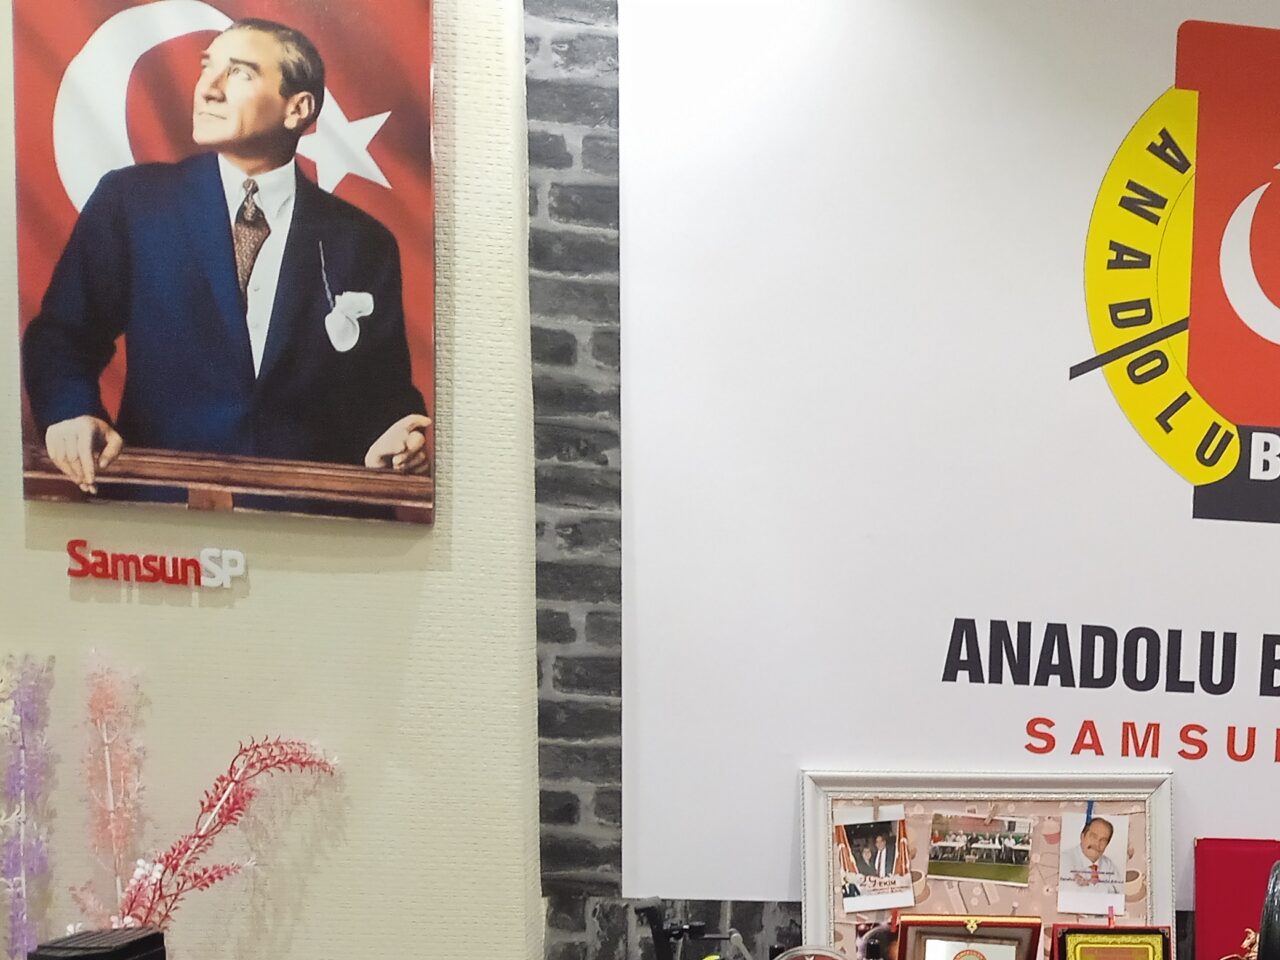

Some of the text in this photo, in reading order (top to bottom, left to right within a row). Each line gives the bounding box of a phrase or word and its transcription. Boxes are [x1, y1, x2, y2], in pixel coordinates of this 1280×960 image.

[1107, 127, 1235, 467] ANADOLU
[66, 539, 245, 588] SamsunSP
[941, 617, 1237, 696] ANADOLU
